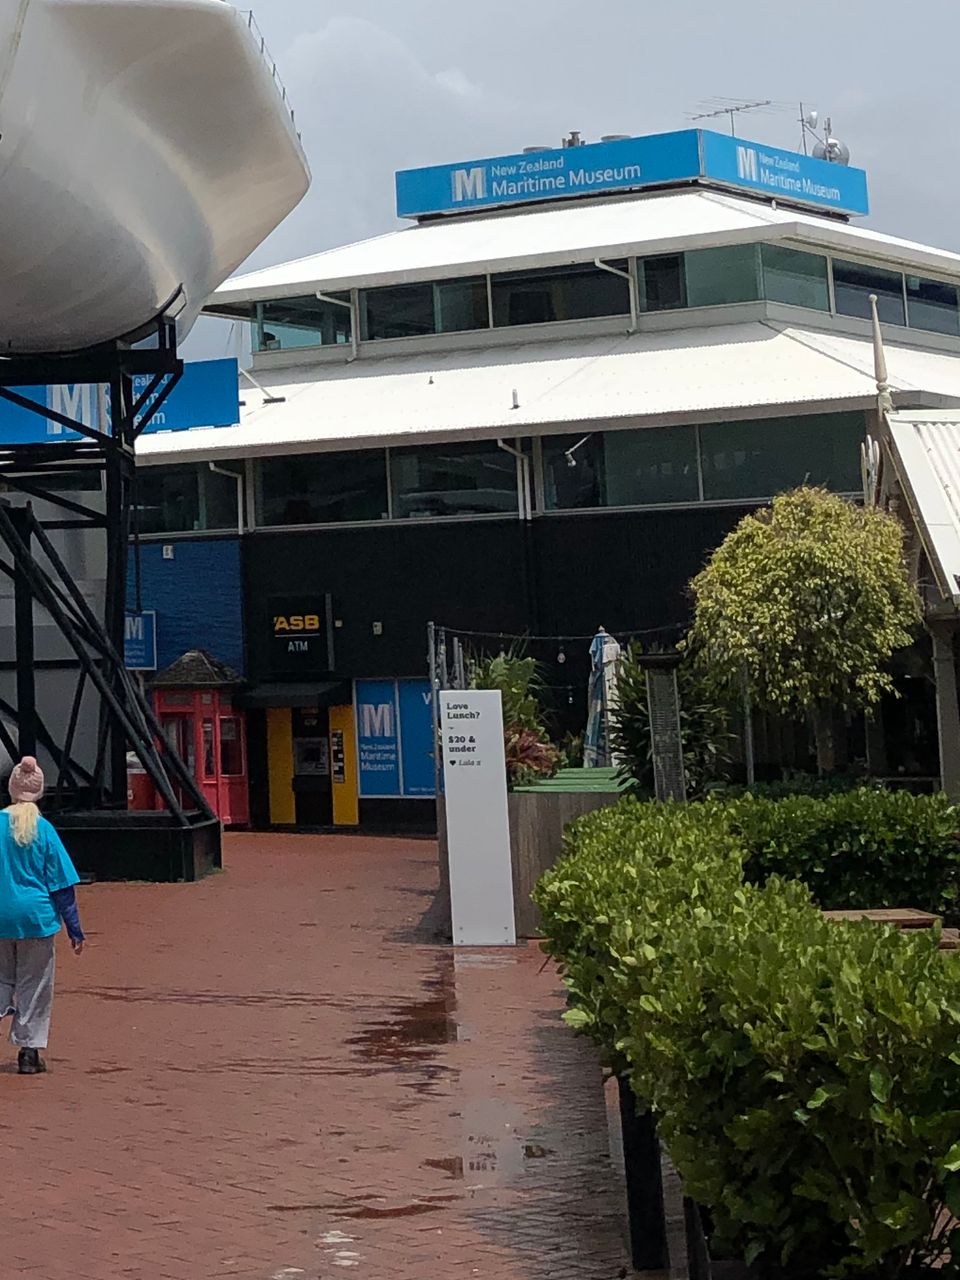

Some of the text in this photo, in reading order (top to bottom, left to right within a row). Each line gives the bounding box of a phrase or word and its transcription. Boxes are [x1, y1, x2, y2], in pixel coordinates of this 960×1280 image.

[491, 156, 565, 177] New Zealand
[759, 152, 800, 172] New Zealand
[452, 168, 487, 202] M
[492, 164, 642, 197] Maritime Museum
[760, 169, 841, 201] Maritime Museum
[275, 615, 320, 631] ASB
[288, 641, 308, 652] ATM
[447, 702, 469, 710] Love
[359, 703, 394, 737] M
[447, 712, 480, 720] Lunch?
[360, 751, 396, 761] Maritime
[449, 744, 477, 753] under
[361, 762, 395, 771] Museum
